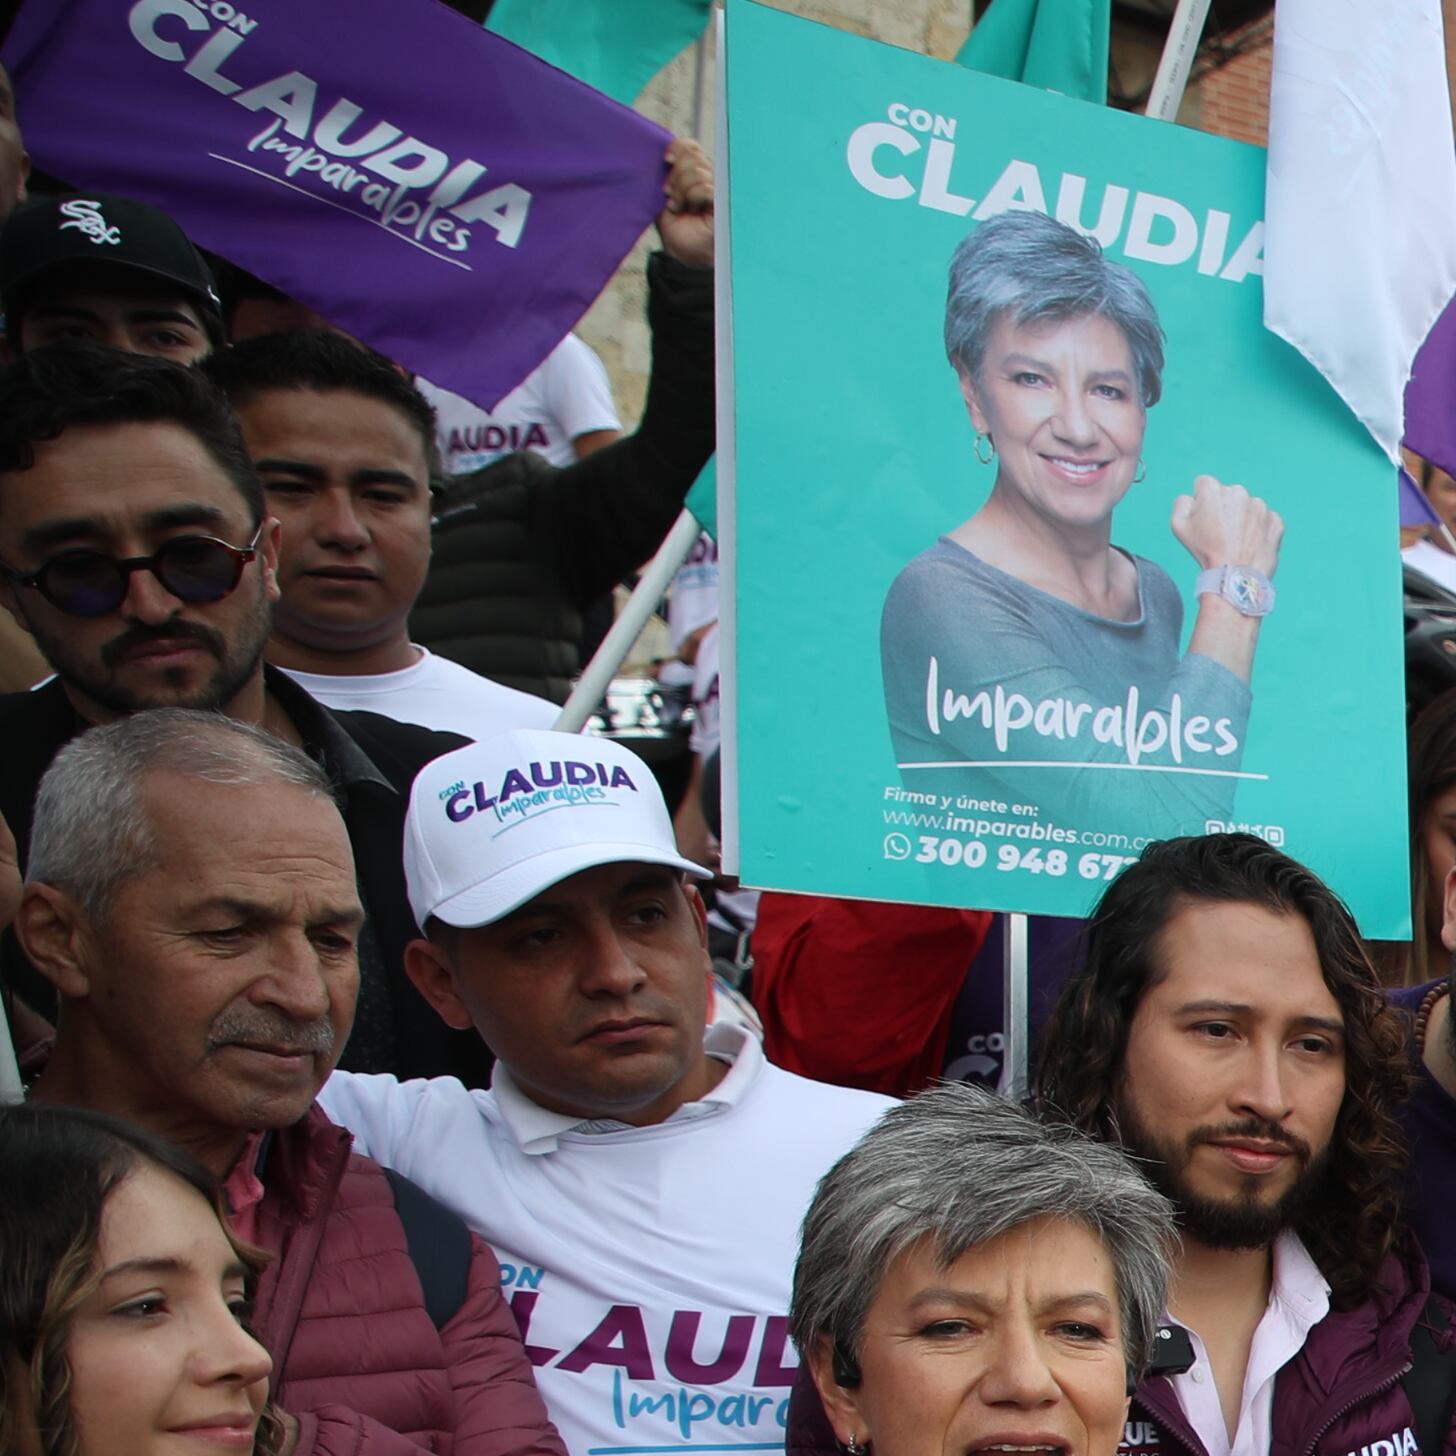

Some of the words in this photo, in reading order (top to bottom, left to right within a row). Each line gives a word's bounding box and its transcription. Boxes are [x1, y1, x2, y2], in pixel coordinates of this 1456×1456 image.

[200, 0, 258, 35] ON
[129, 0, 532, 248] CLAUDIA
[887, 102, 958, 140] CON
[248, 118, 470, 252] Imparables
[447, 422, 550, 454] AUDIA
[926, 655, 1239, 766] Imparables
[445, 760, 639, 823] CLAUDIA
[490, 780, 607, 823] Imparables
[883, 786, 936, 807] Firma
[940, 794, 952, 811] y
[956, 793, 1008, 814] únete
[1012, 801, 1040, 817] en:
[916, 836, 987, 868] 300
[997, 843, 1068, 877] 948
[967, 1031, 1006, 1054] CO
[500, 1262, 545, 1290] ON
